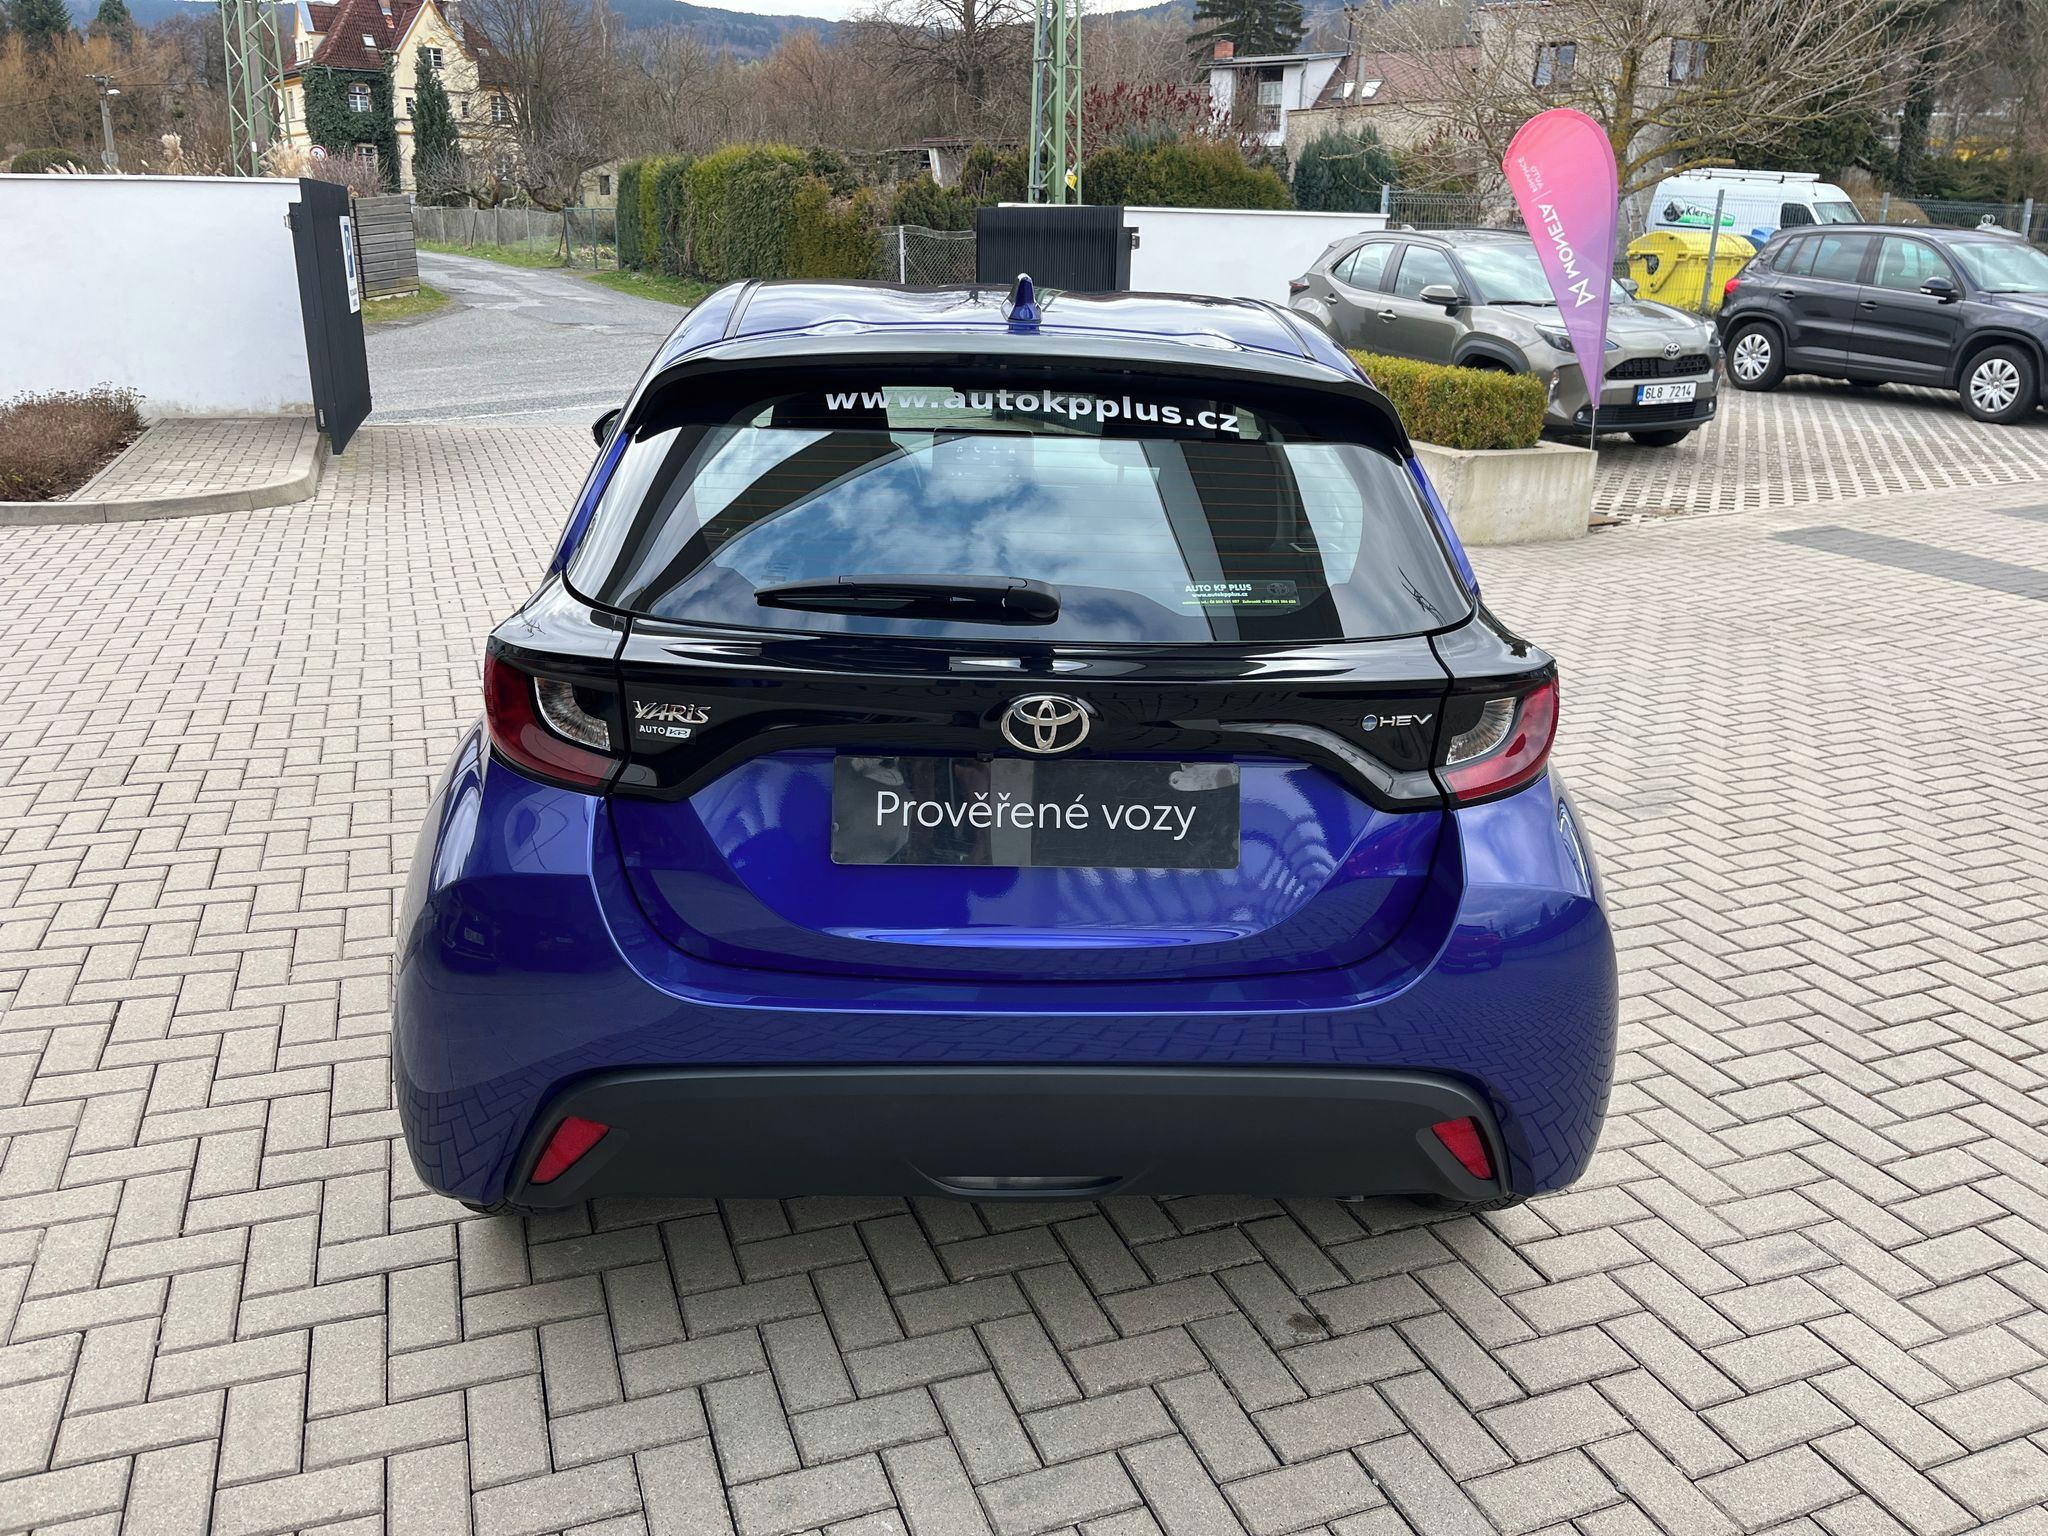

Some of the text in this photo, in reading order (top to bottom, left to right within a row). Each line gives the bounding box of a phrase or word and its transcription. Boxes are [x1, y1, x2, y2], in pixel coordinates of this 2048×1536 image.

[1645, 385, 1691, 399] 6L8 7214
[825, 389, 1239, 432] www.autokpplus.cz
[1185, 584, 1211, 592] AUTO
[1228, 583, 1252, 591] PLUS
[1379, 713, 1433, 727] HEV
[639, 725, 665, 735] AUTO
[876, 790, 1197, 841] Prověřené vozy
